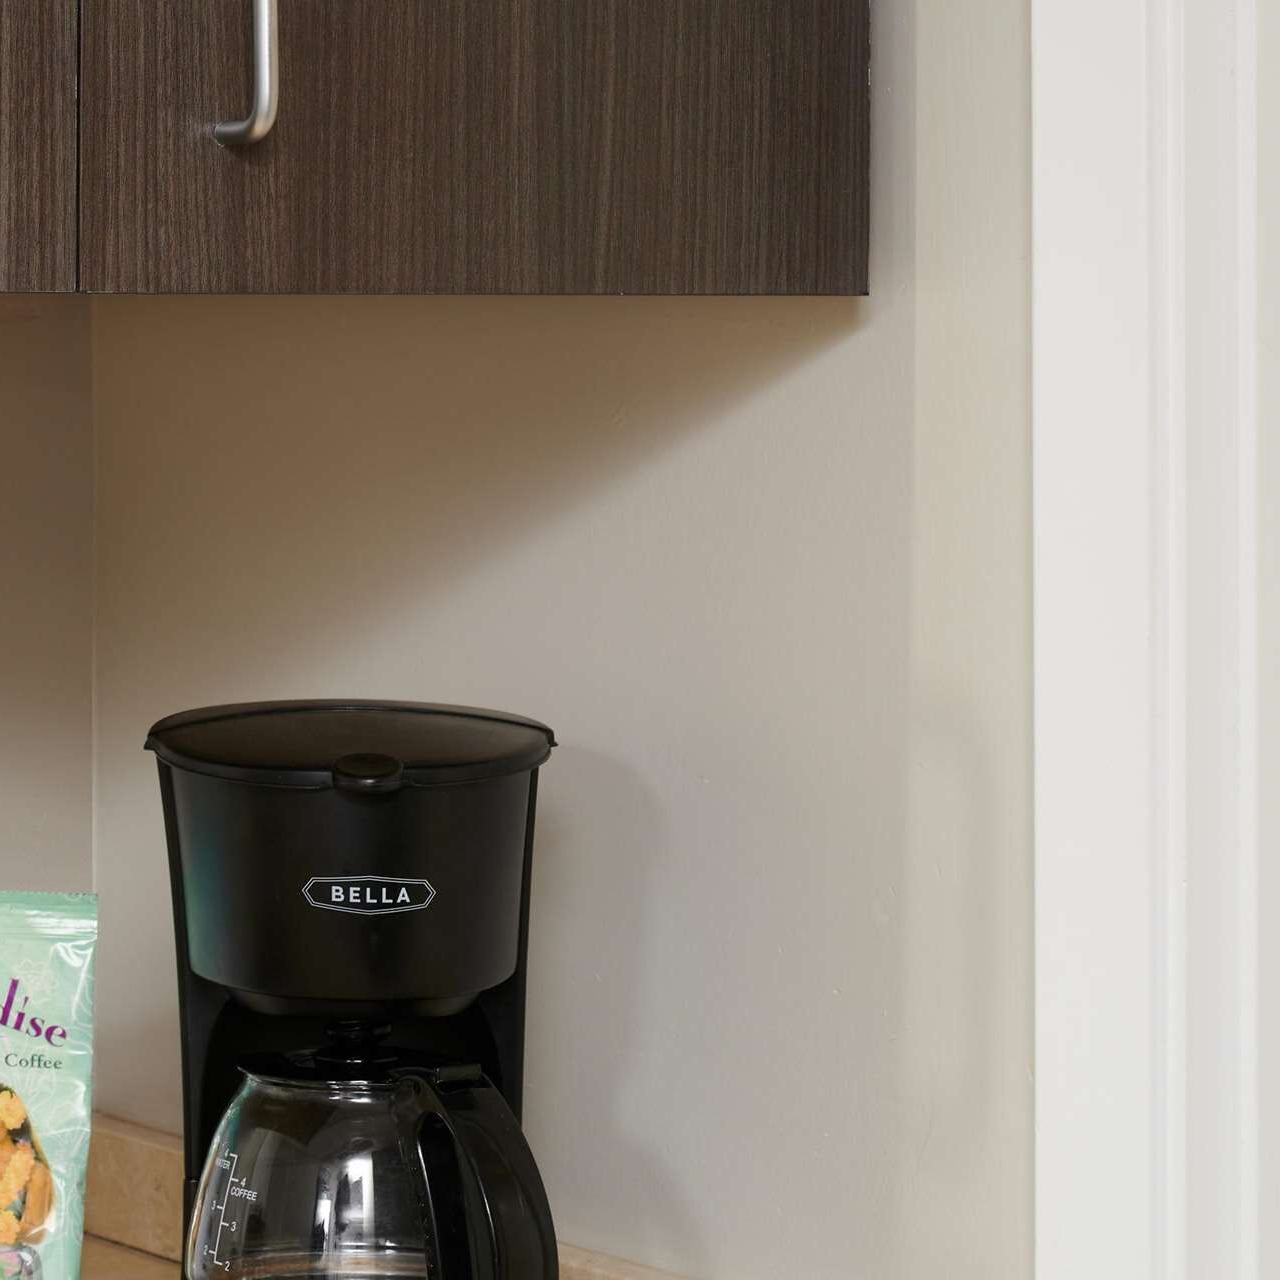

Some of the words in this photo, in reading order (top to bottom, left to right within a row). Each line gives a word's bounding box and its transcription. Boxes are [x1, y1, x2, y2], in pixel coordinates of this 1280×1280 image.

[331, 885, 411, 904] BELLA
[4, 1053, 63, 1069] Coffee
[240, 1177, 248, 1188] 4
[230, 1186, 258, 1201] COFFEE
[230, 1221, 237, 1232] 3
[224, 1260, 231, 1272] 2
